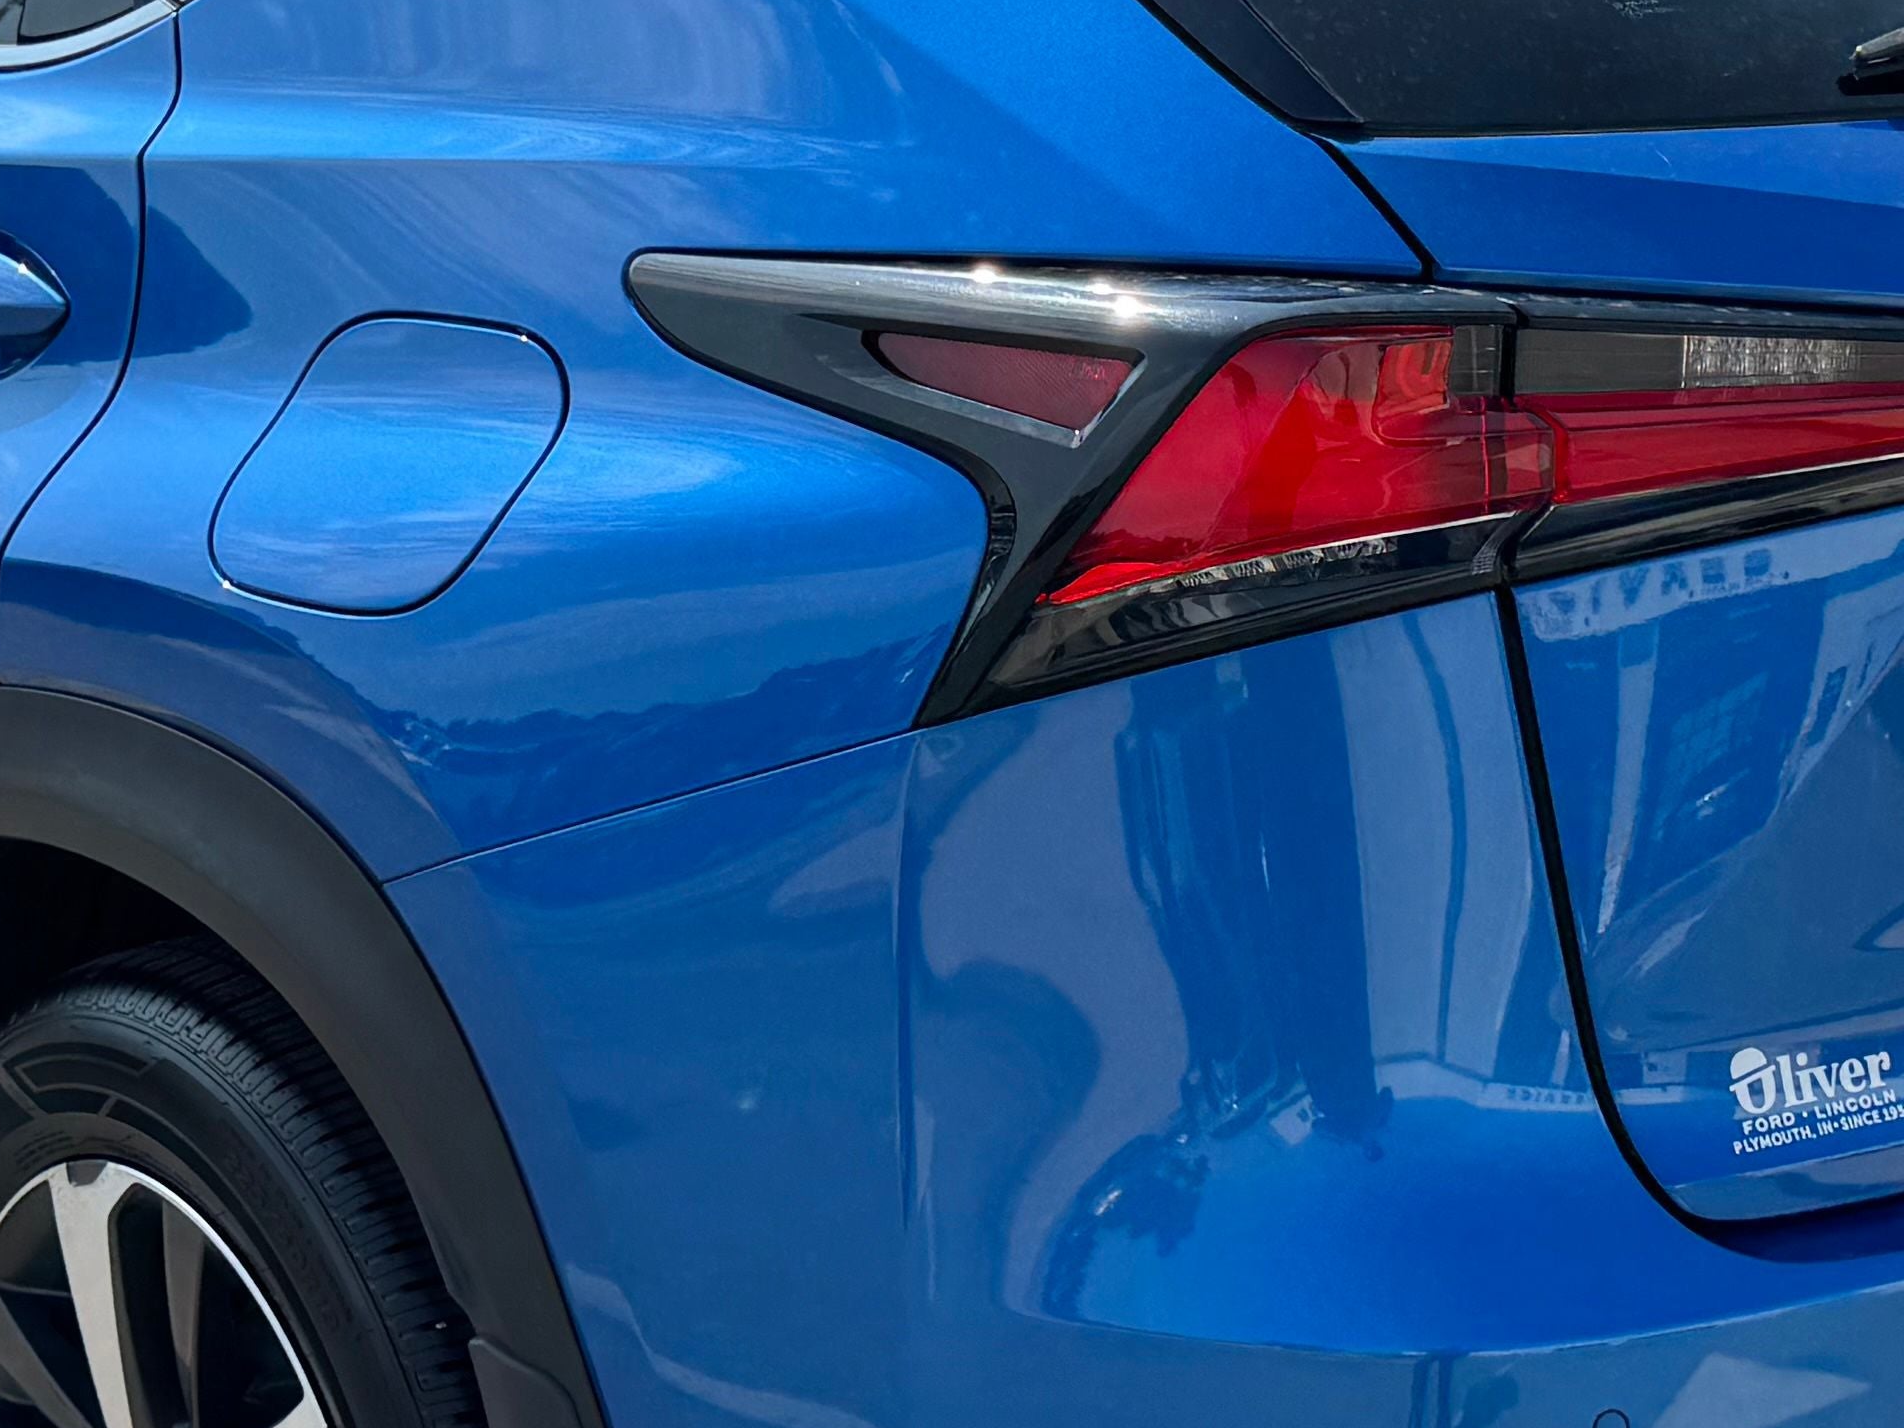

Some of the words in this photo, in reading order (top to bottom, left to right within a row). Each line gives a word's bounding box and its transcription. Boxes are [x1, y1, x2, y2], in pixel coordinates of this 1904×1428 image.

[1729, 1046, 1891, 1115] Oliver
[1742, 1112, 1795, 1135] FORD
[1813, 1089, 1896, 1119] LINCOLN
